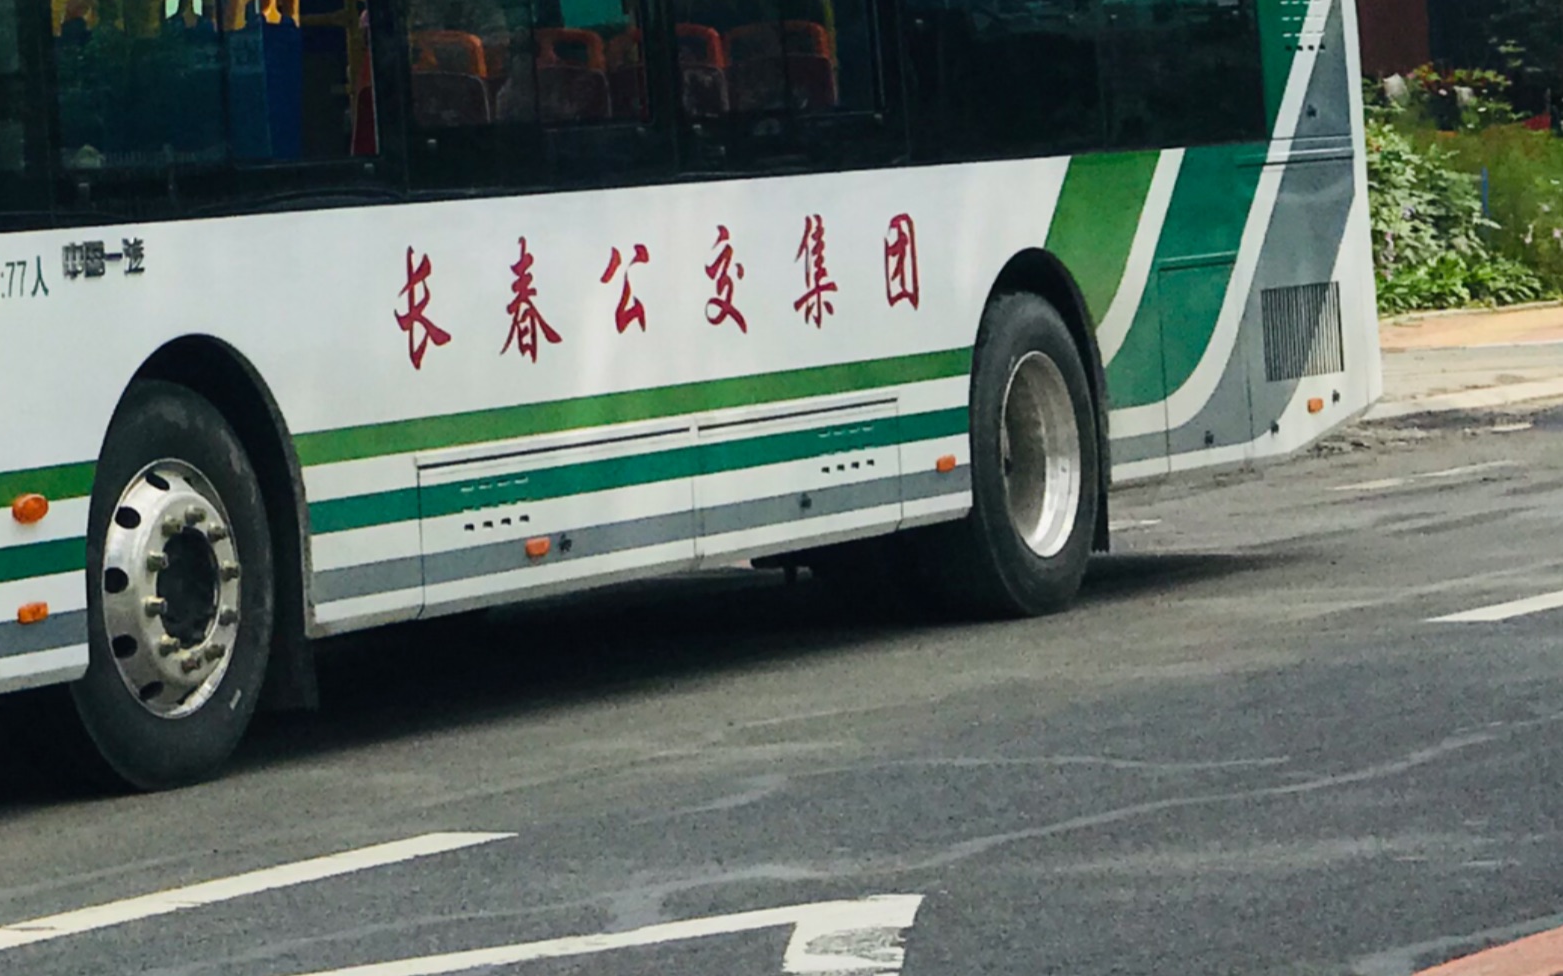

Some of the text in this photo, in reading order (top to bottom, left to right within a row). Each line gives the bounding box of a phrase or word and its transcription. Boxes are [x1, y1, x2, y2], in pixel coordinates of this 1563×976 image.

[394, 213, 920, 370] 长春公交集团
